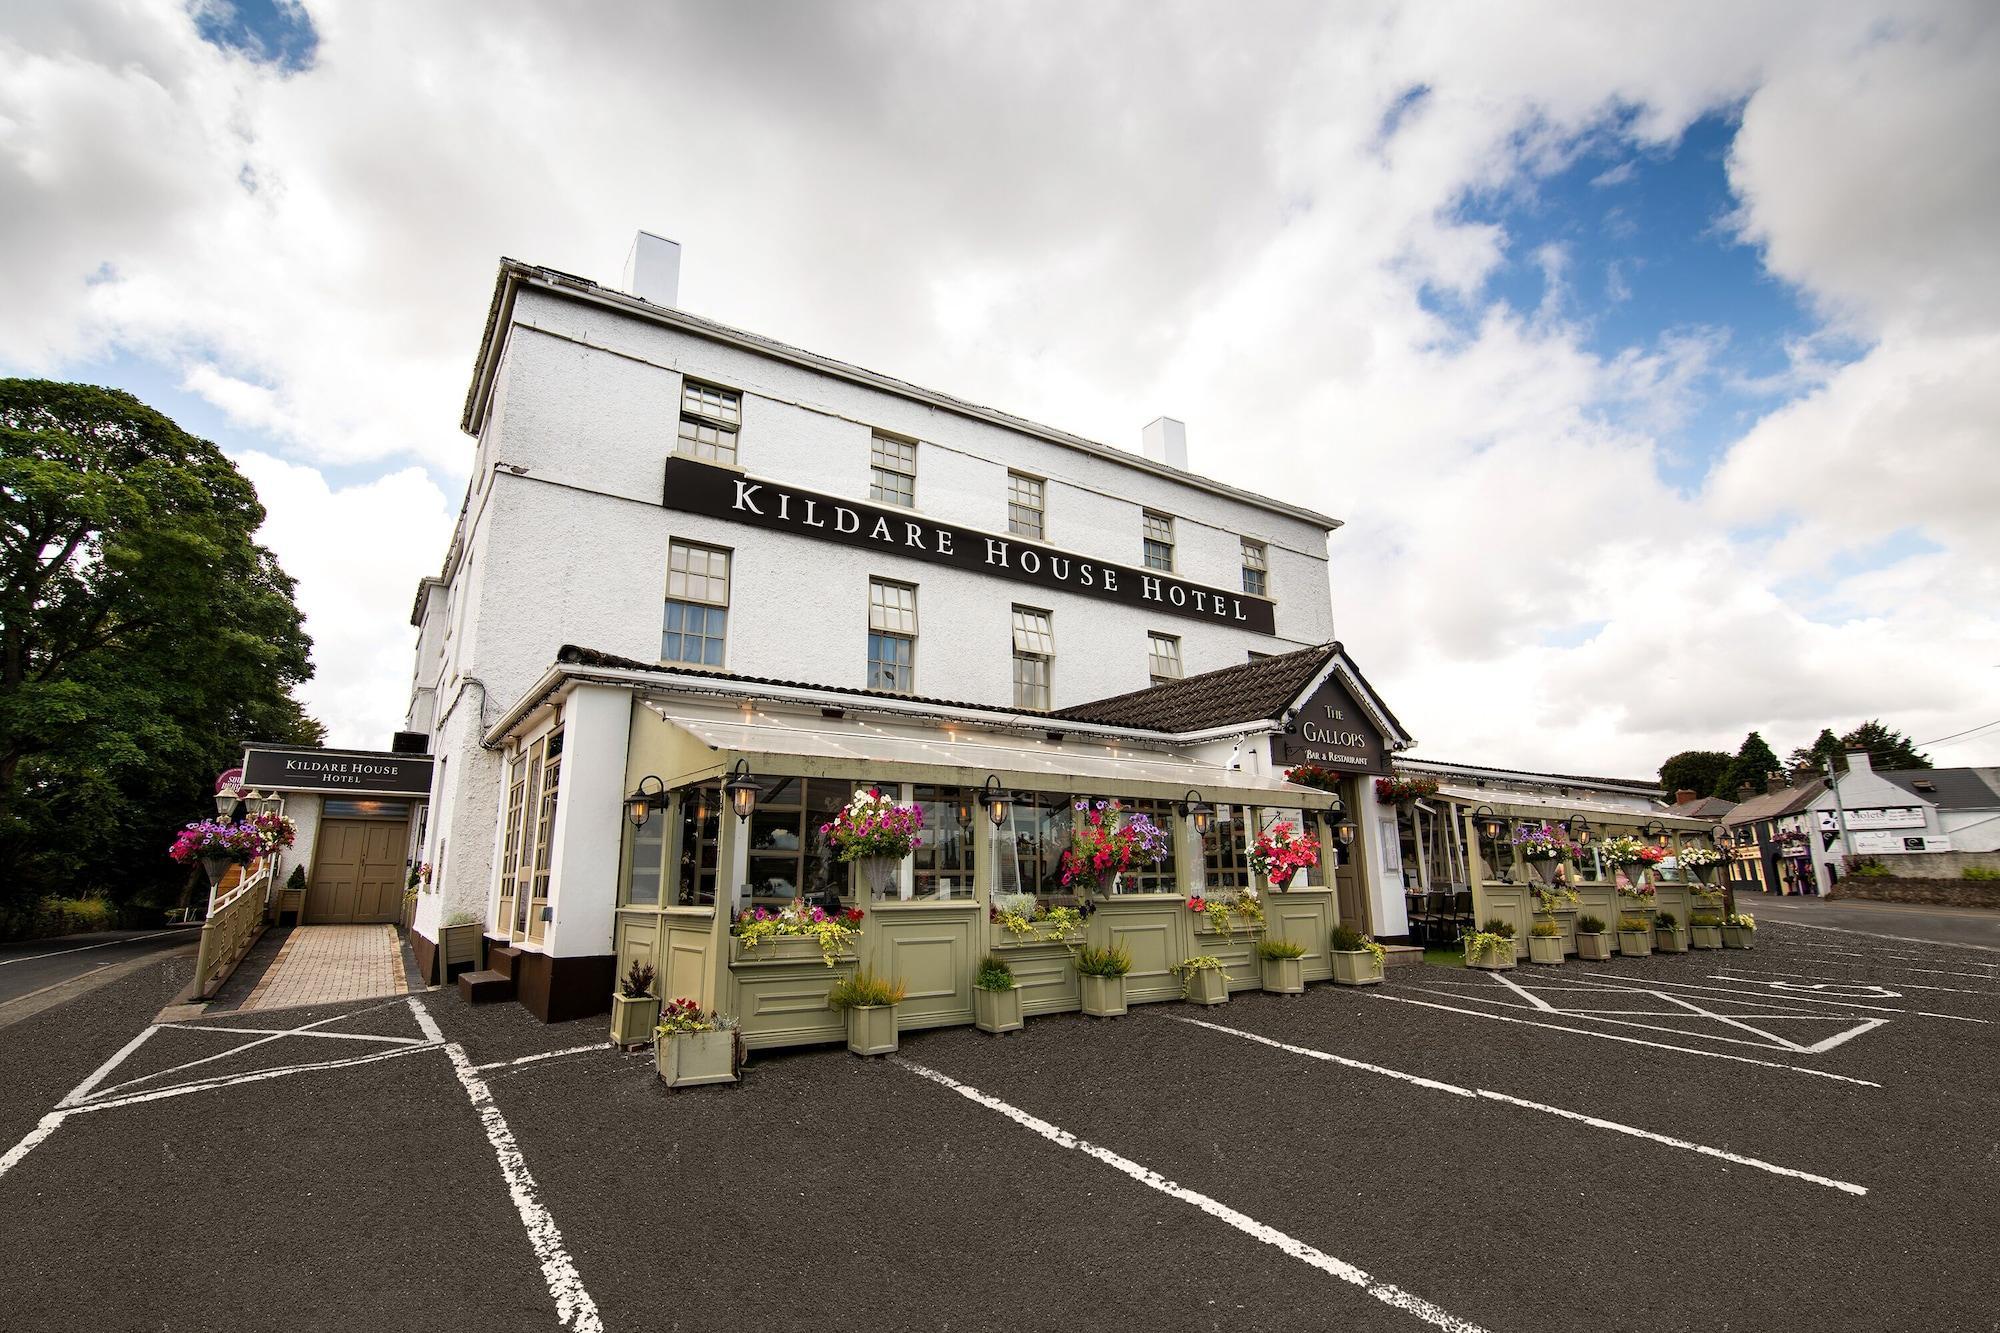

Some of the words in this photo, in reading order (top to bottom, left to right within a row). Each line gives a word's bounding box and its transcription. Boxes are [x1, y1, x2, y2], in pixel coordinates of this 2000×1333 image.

[732, 479, 954, 555] KILDARE
[984, 538, 1118, 592] HOUSE
[1141, 575, 1247, 621] HOTEL
[1324, 704, 1344, 720] THE
[1303, 721, 1366, 748] GALLOPS
[1305, 749, 1321, 761] BAR
[1321, 753, 1327, 761] &
[1328, 751, 1368, 766] RESTAURANT
[285, 759, 348, 773] KILDARE
[351, 763, 399, 775] HOUSE
[322, 773, 361, 784] HOTEL
